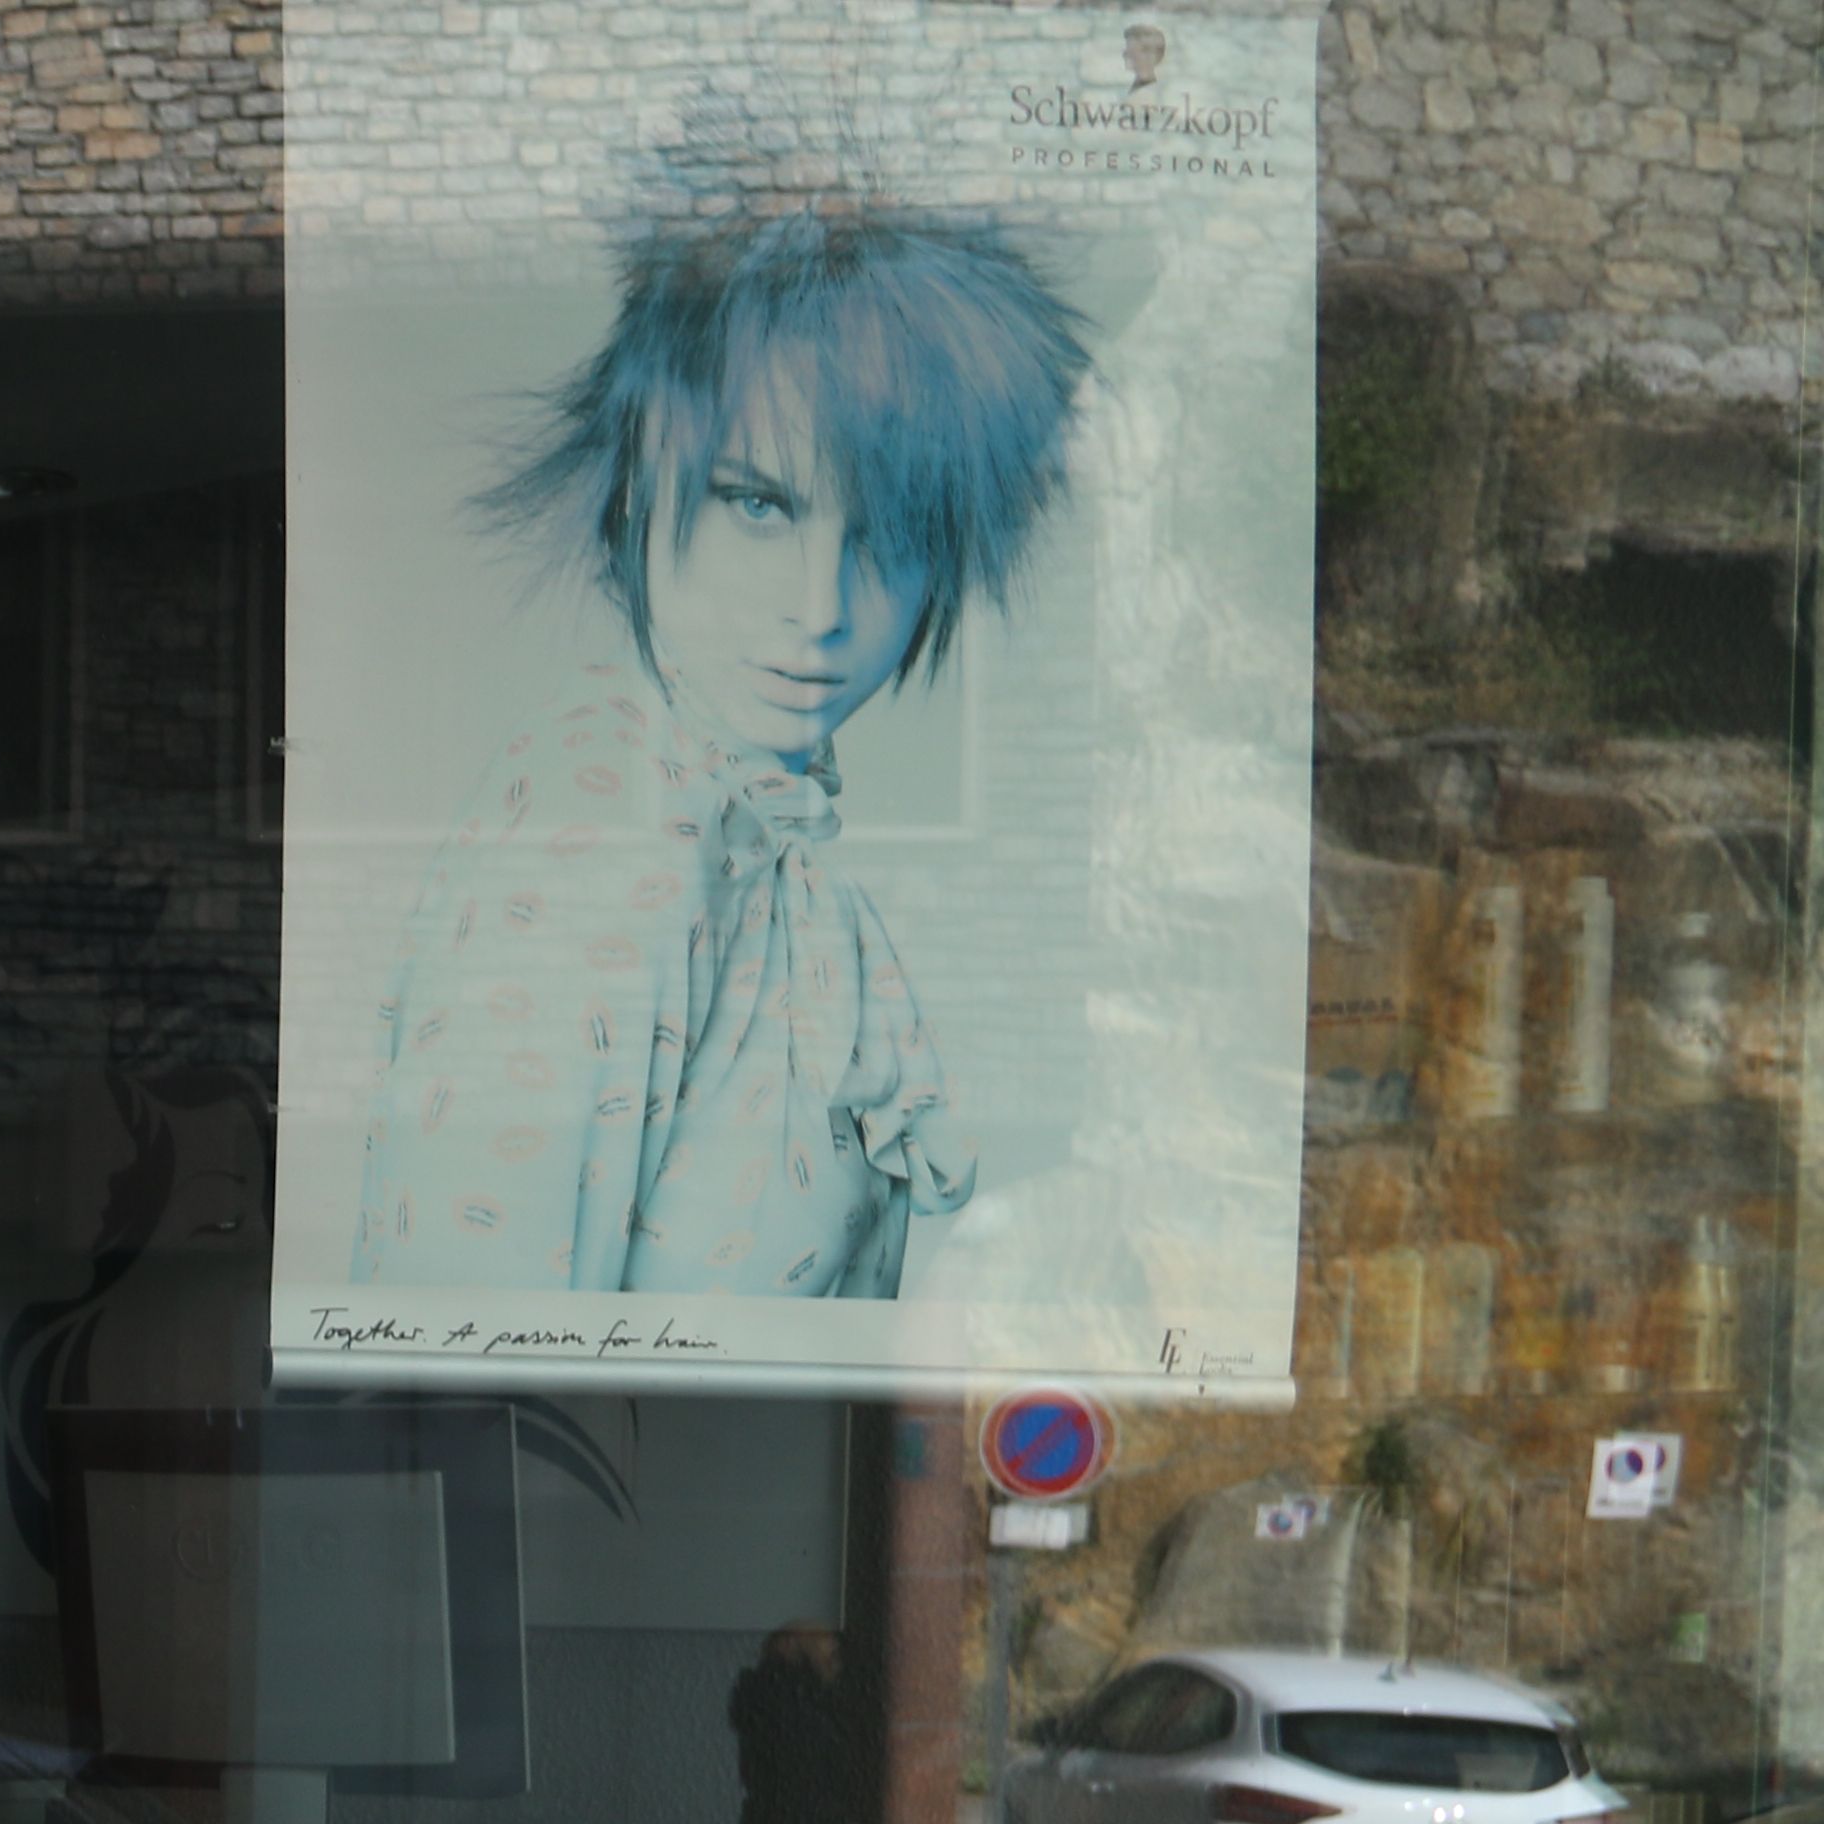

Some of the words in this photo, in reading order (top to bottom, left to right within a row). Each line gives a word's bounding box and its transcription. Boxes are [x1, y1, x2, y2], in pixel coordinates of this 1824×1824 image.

[1009, 84, 1279, 151] Schwarzkopf
[1011, 146, 1276, 179] PROFESSIONAL
[441, 1321, 478, 1347] A
[595, 1319, 643, 1358] for
